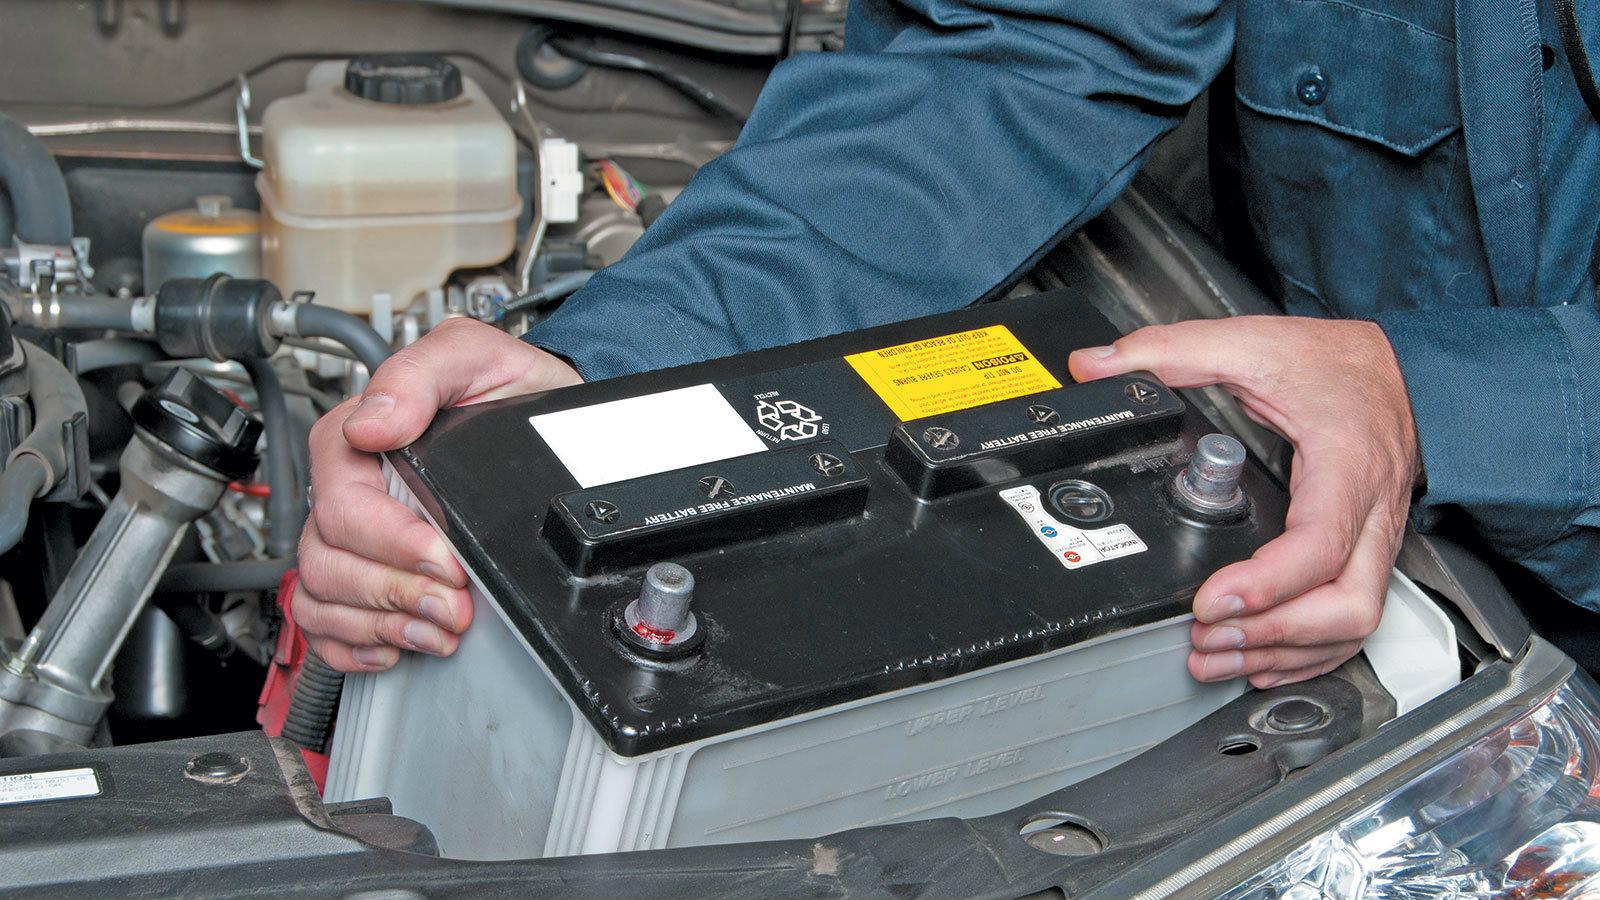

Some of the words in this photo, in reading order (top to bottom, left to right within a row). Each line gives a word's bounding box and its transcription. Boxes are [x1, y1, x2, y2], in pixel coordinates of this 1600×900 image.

[969, 330, 989, 338] KEEP
[921, 339, 946, 348] REACH
[876, 346, 912, 357] CHILDREN
[972, 355, 1016, 368] POISON
[915, 370, 944, 380] SEVERE
[942, 364, 972, 375] CAUSES
[981, 371, 995, 379] TIP
[994, 368, 1011, 376] NOT
[891, 376, 918, 385] BURNS
[753, 391, 779, 400] RECYCLE
[1057, 410, 1135, 432] MAINTENANCE
[756, 430, 780, 443] RETURN
[1028, 428, 1058, 440] FREE
[980, 433, 1028, 451] BATTERY
[730, 482, 816, 506] MAINTENANCE
[701, 500, 731, 513] FREE
[644, 506, 698, 525] BATTERY
[1099, 540, 1138, 553] INDICATOR
[904, 705, 975, 737] UPPER
[979, 685, 1047, 717] LEVEL
[885, 767, 960, 800] LOWER
[964, 750, 1025, 779] LEVEL
